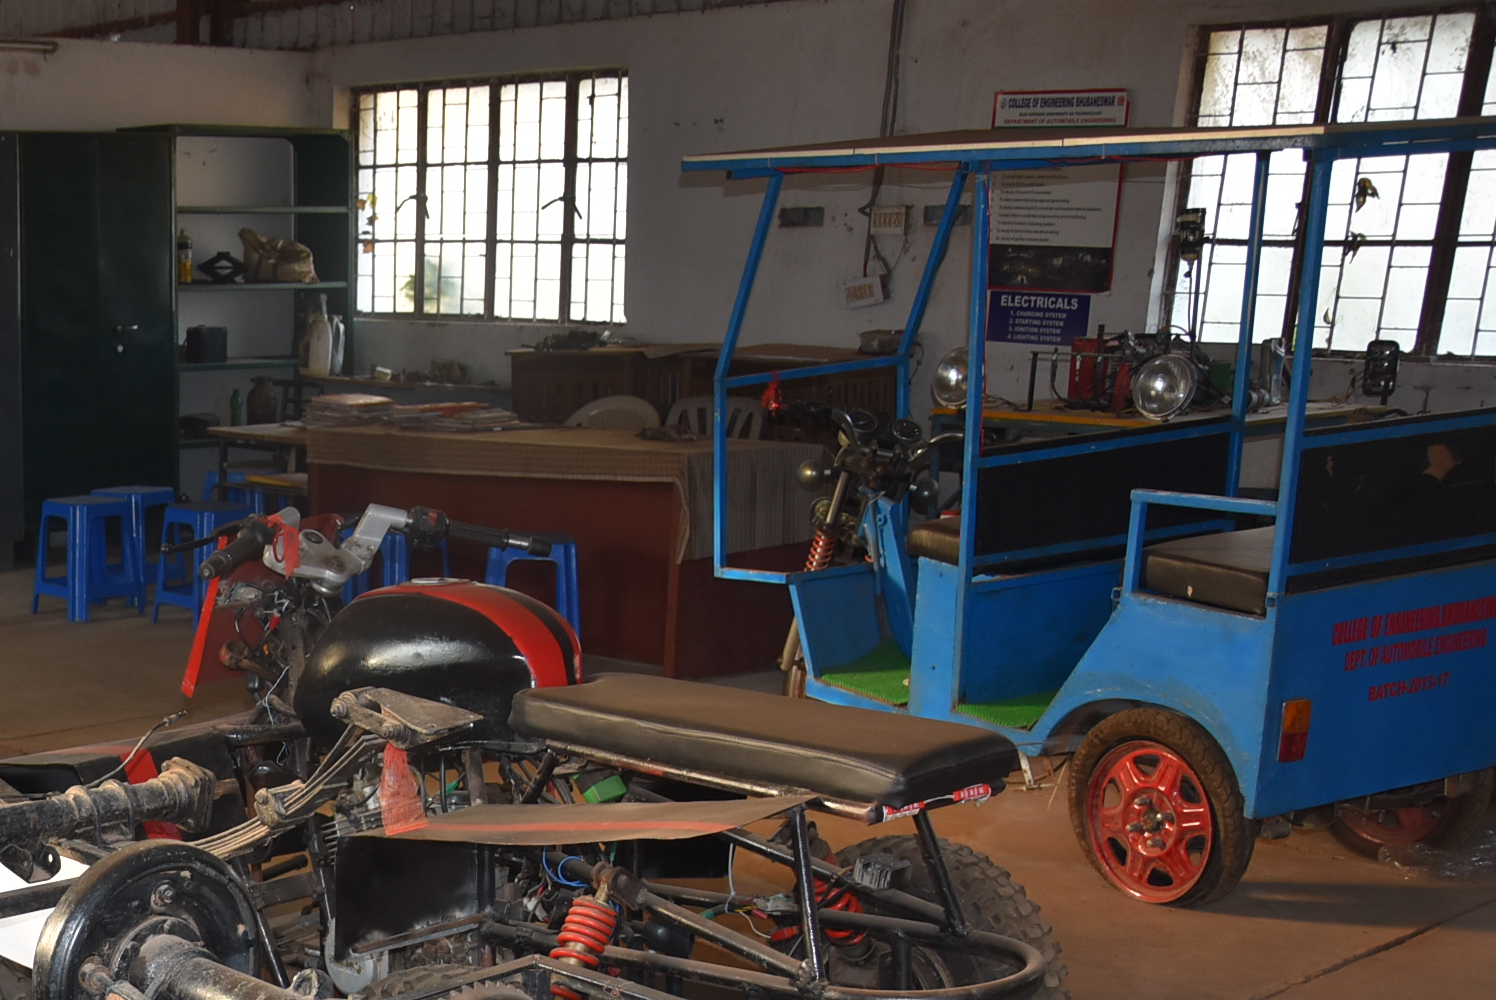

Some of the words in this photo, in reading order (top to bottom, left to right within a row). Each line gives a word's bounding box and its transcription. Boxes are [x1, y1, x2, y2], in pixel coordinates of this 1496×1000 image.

[1008, 97, 1031, 109] COLLEGE
[1032, 97, 1039, 108] OF
[1039, 96, 1075, 108] ENGINEERING
[1075, 95, 1116, 107] BHUBANESWAR
[1000, 294, 1078, 310] ELECTRICALS
[1332, 617, 1370, 646] COLLEGE
[1371, 614, 1384, 639] OF
[1344, 648, 1368, 672] DEPT.
[1368, 646, 1381, 667] OF
[1381, 636, 1435, 664] AUTOMOBILE
[1435, 627, 1489, 655] ENGINEERING
[1368, 671, 1451, 701] BATCH-2013-17
